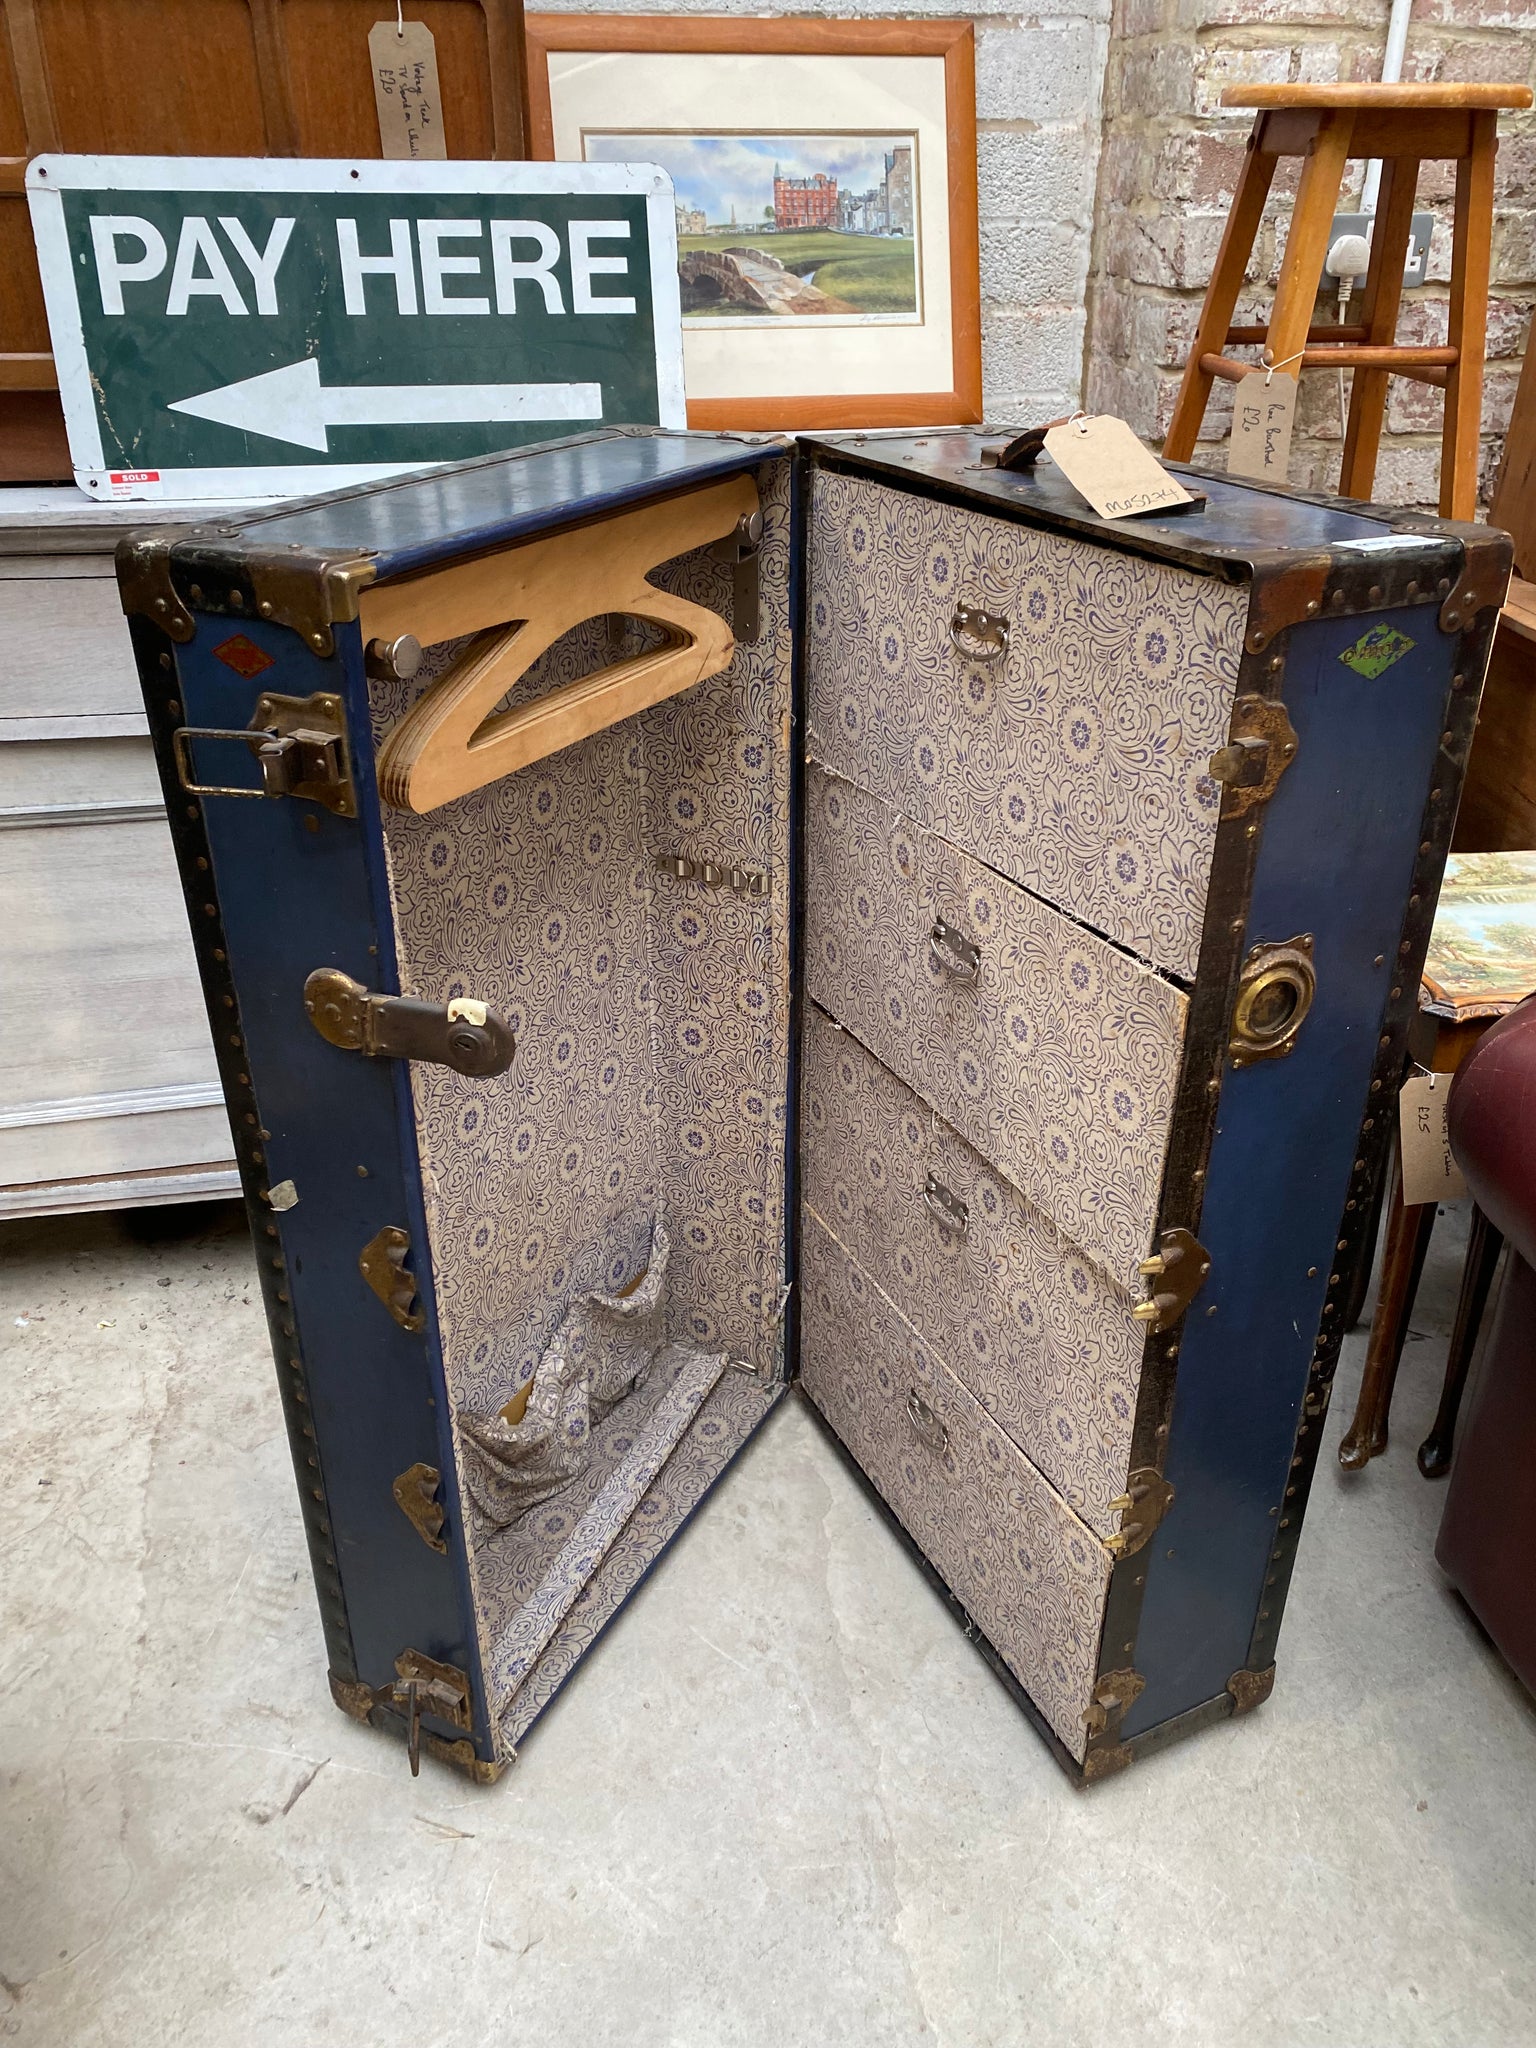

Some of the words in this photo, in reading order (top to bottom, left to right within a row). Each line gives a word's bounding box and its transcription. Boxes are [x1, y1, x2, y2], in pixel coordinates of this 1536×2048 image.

[379, 68, 396, 95] £20
[398, 65, 409, 82] TV
[89, 214, 296, 317] PAY
[335, 218, 637, 316] HERE
[1242, 406, 1261, 432] £20
[122, 474, 148, 482] SOLD
[1418, 1106, 1431, 1134] £25
